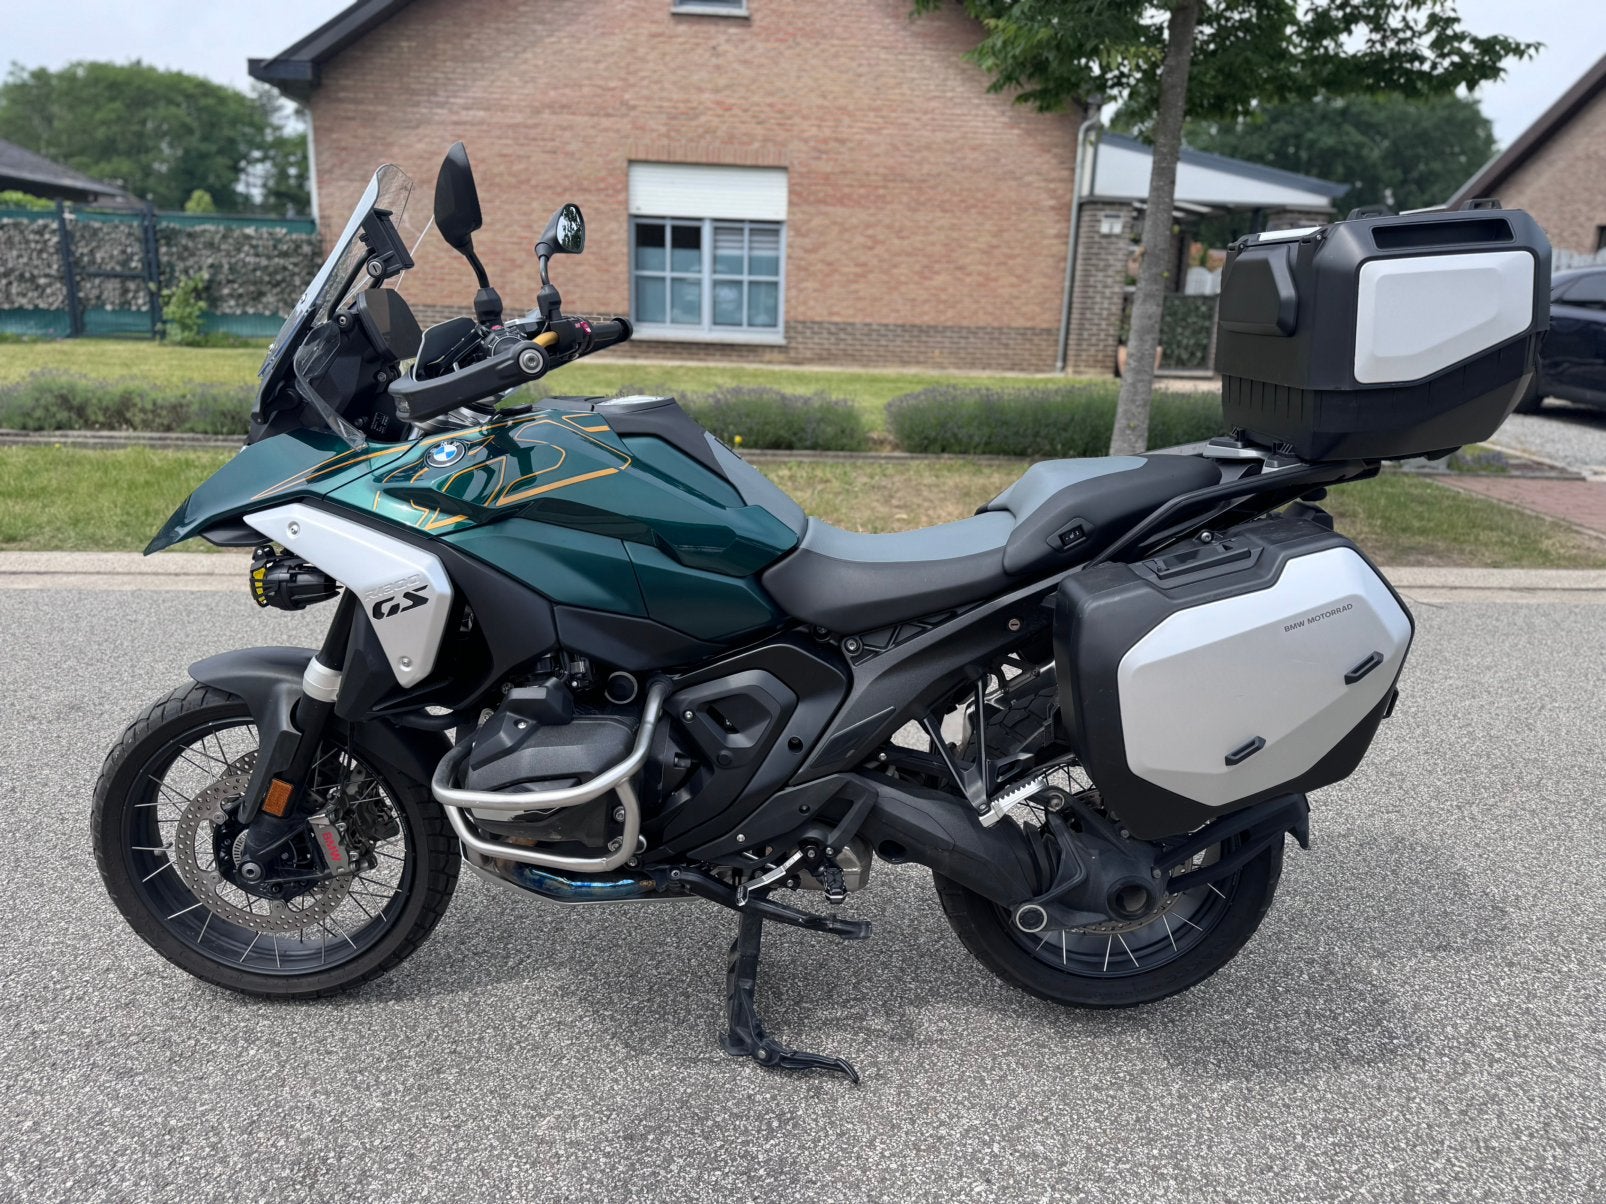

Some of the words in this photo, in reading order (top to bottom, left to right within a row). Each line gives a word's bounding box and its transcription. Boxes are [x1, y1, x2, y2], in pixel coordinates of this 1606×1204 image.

[372, 584, 429, 620] GS
[1283, 620, 1305, 633] BMW
[1307, 603, 1353, 625] MOTORRAD
[322, 831, 343, 861] BMW
